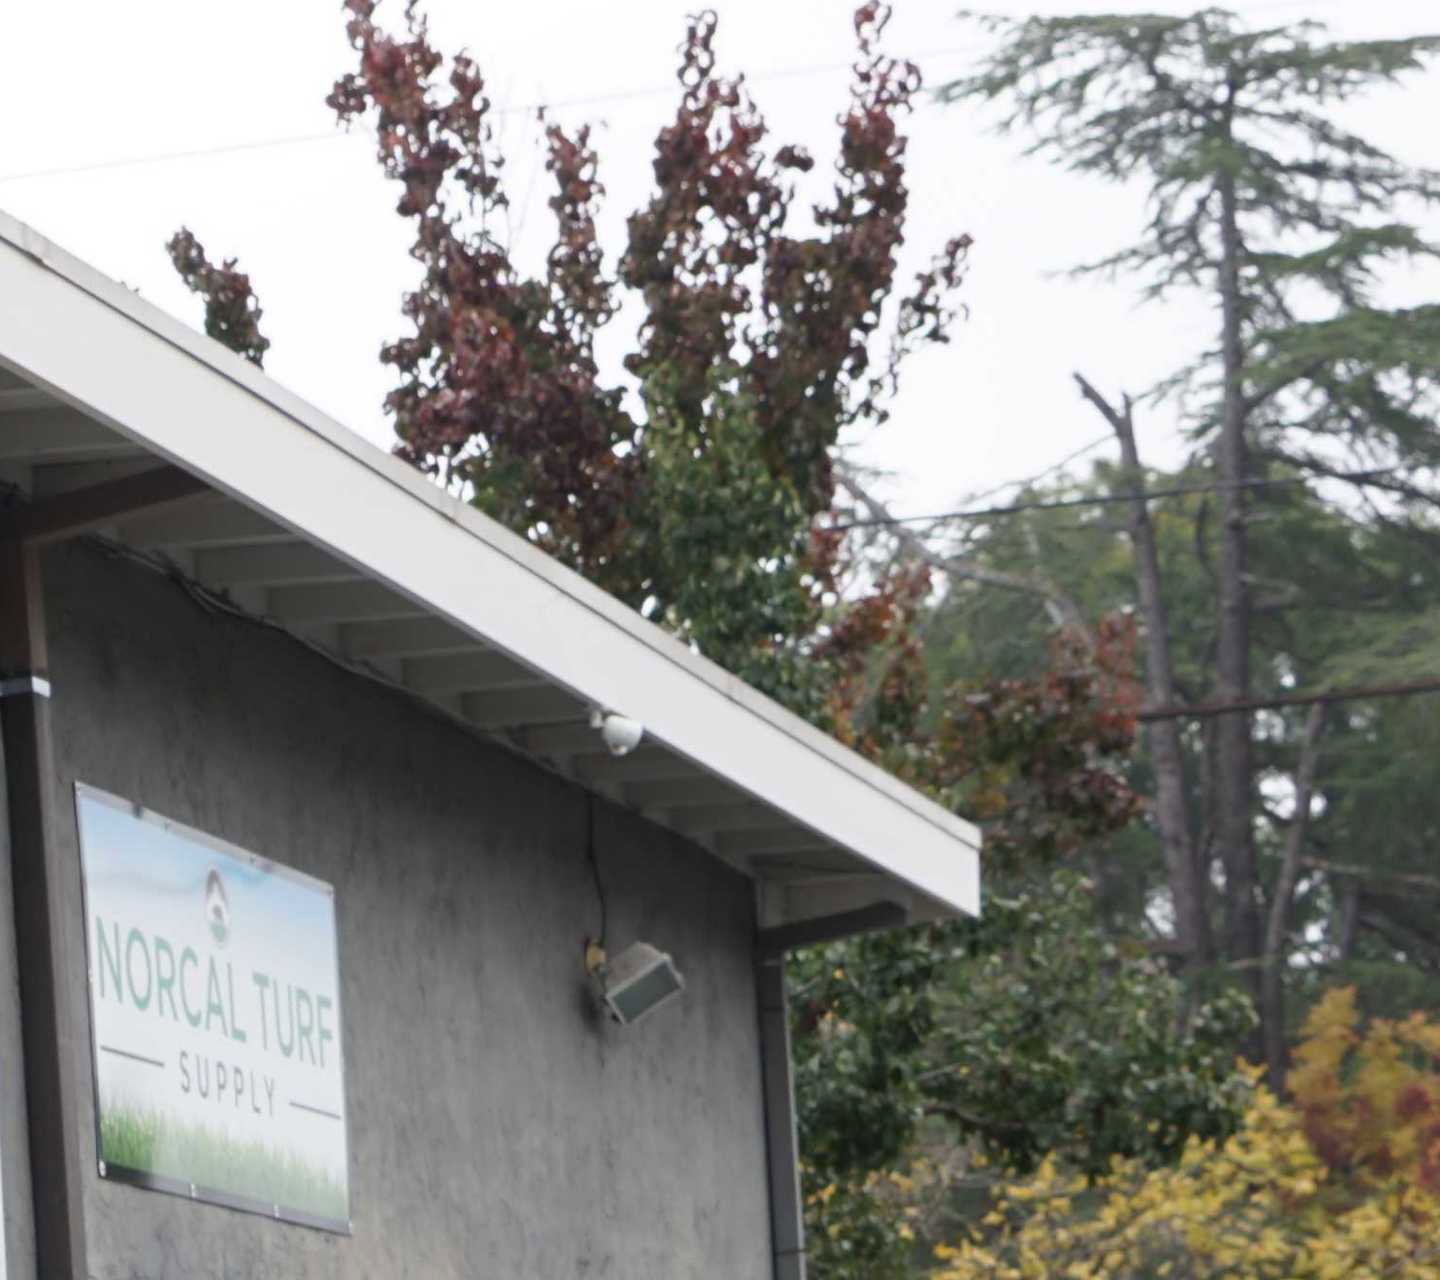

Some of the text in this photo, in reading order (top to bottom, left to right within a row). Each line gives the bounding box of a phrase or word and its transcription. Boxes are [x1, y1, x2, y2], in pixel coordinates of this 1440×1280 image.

[95, 916, 333, 1068] NORCAL TURF
[179, 1050, 275, 1117] SUPPLY
